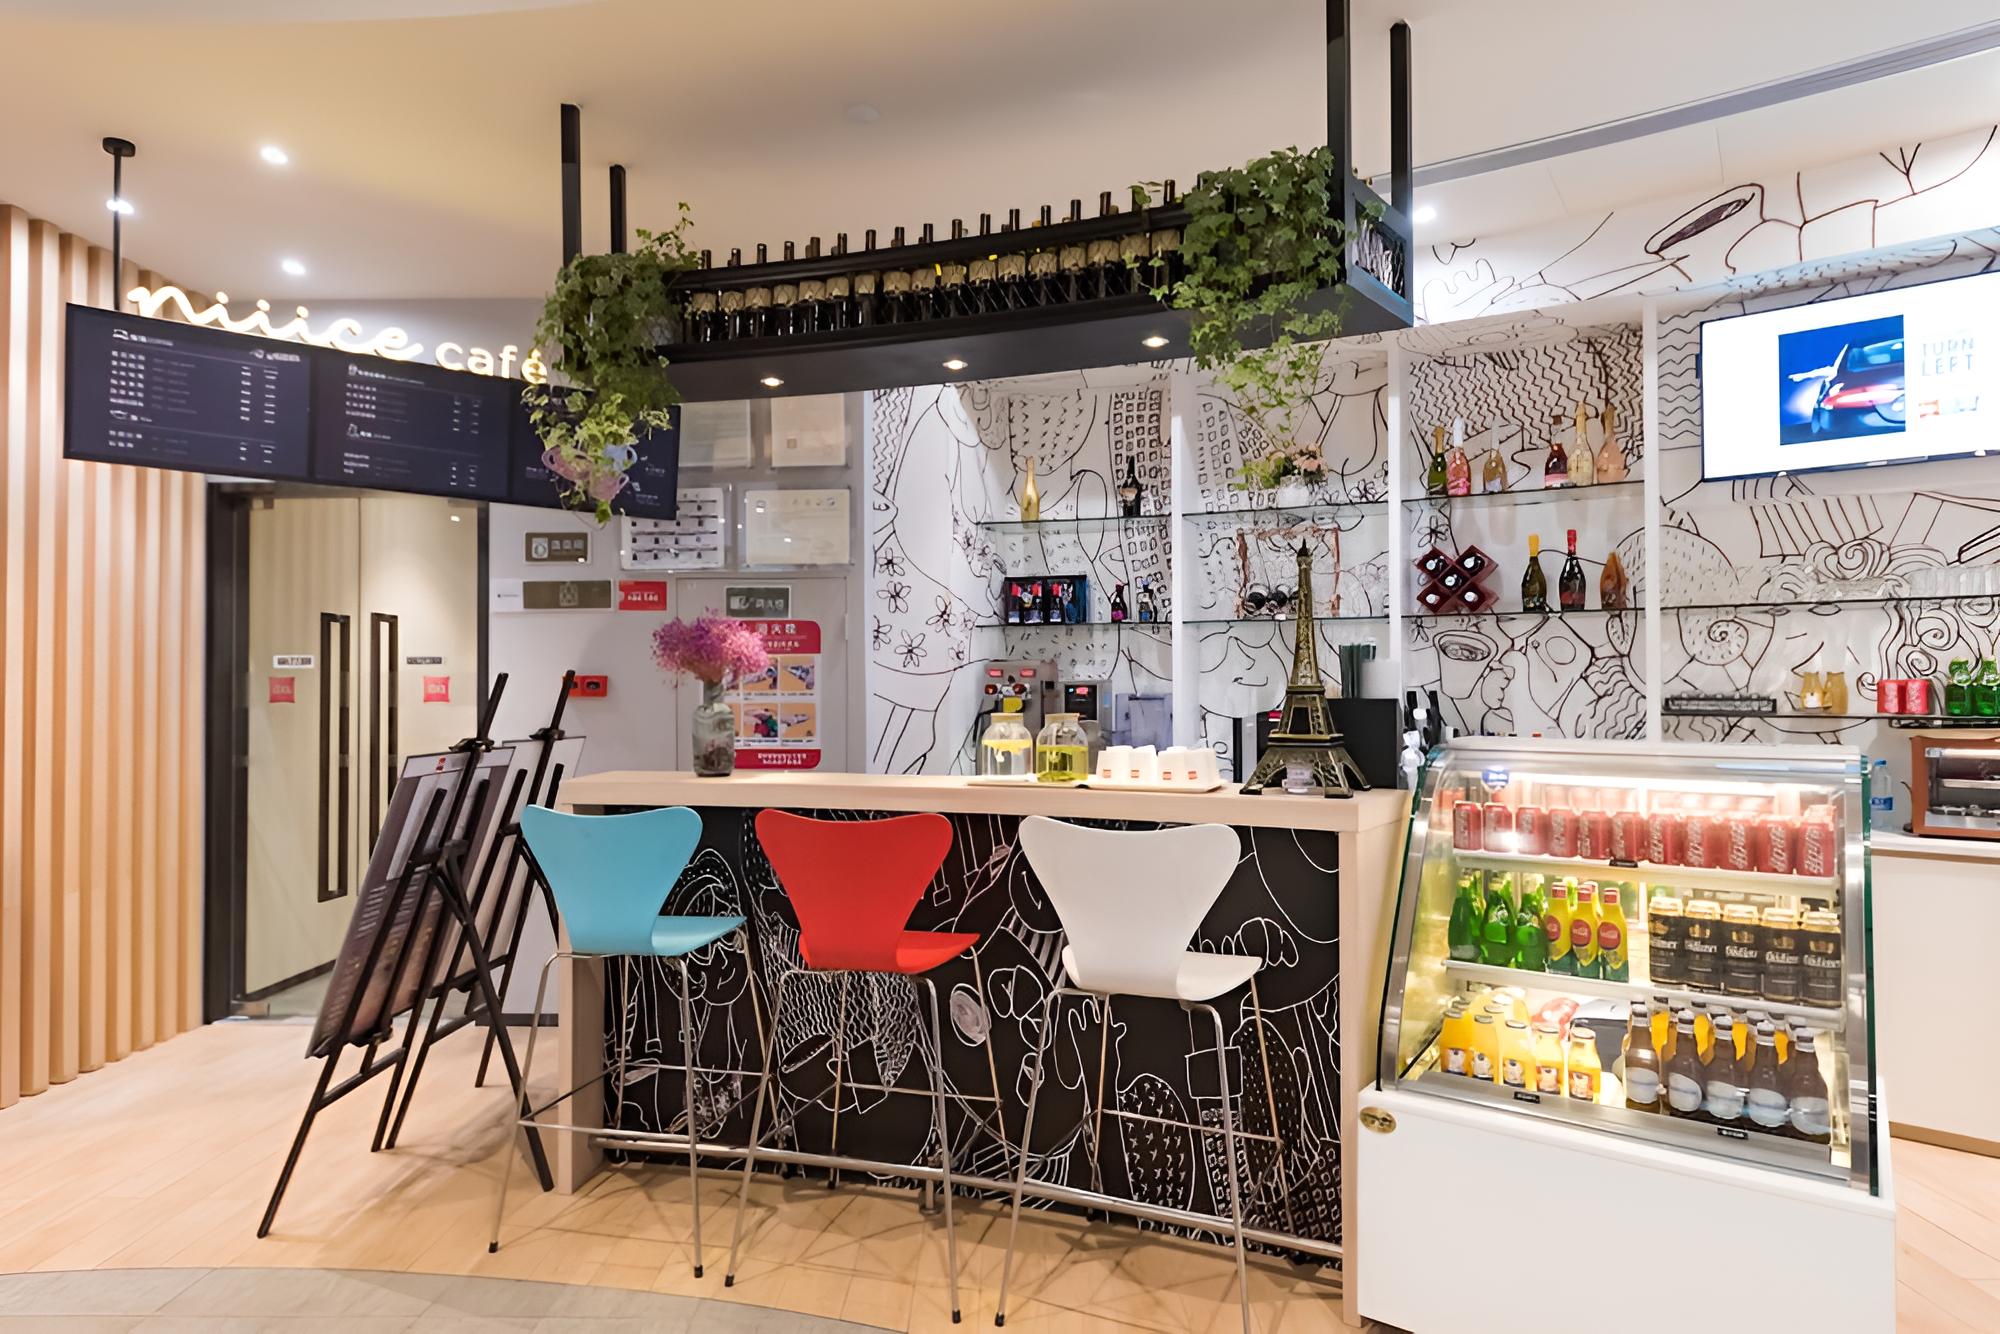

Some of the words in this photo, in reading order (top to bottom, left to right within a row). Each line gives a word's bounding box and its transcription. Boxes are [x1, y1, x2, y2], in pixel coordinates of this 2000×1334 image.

[1922, 337, 1974, 356] TURN
[435, 342, 548, 384] café
[1921, 353, 1974, 377] LEFT
